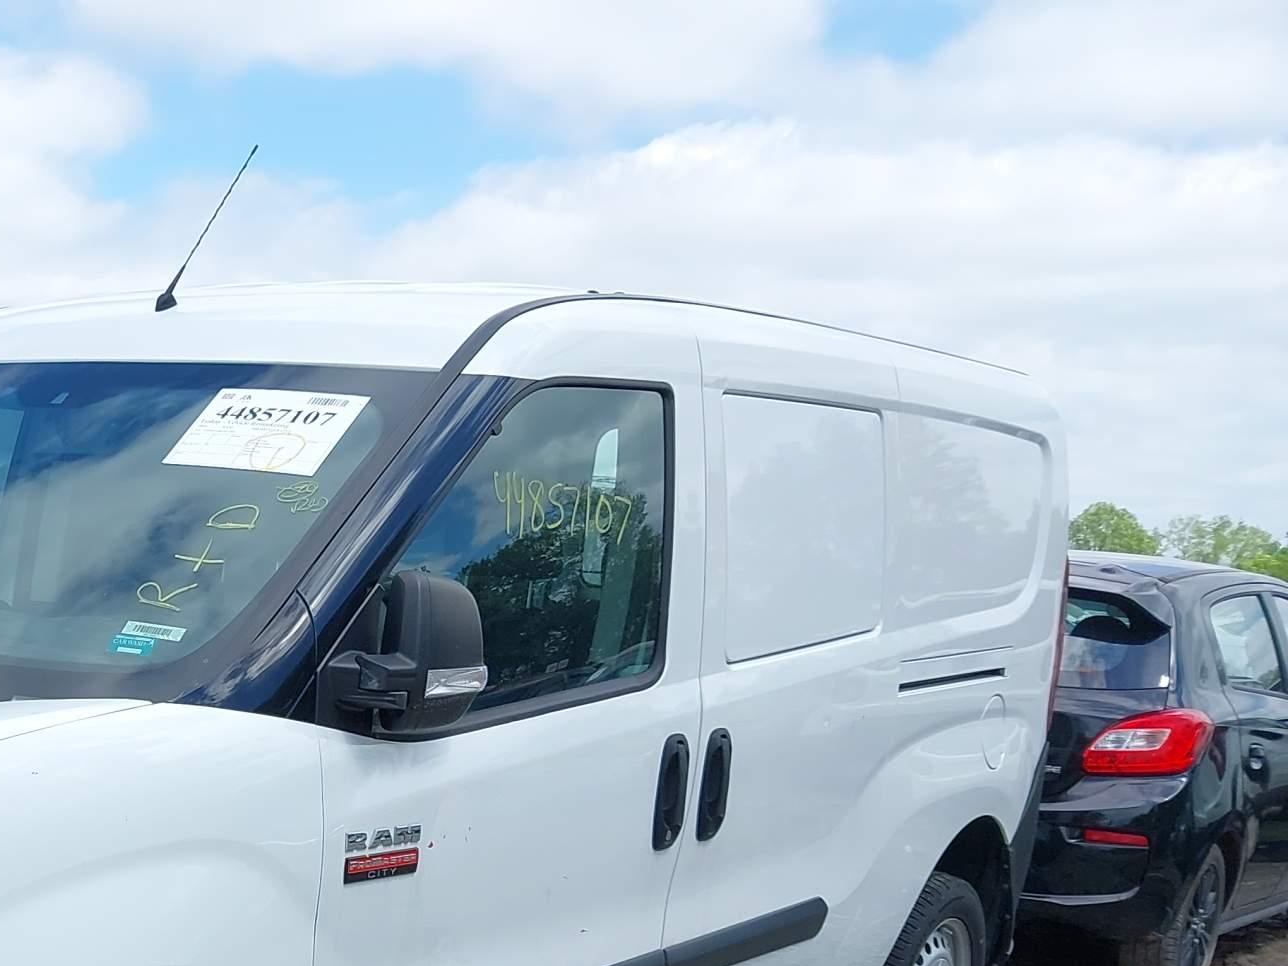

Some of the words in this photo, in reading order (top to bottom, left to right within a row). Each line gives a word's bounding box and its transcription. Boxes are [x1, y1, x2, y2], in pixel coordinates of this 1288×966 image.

[216, 405, 337, 426] 44857107
[493, 471, 632, 545] 44857107
[345, 825, 422, 852] RAM
[368, 867, 398, 879] CITY
